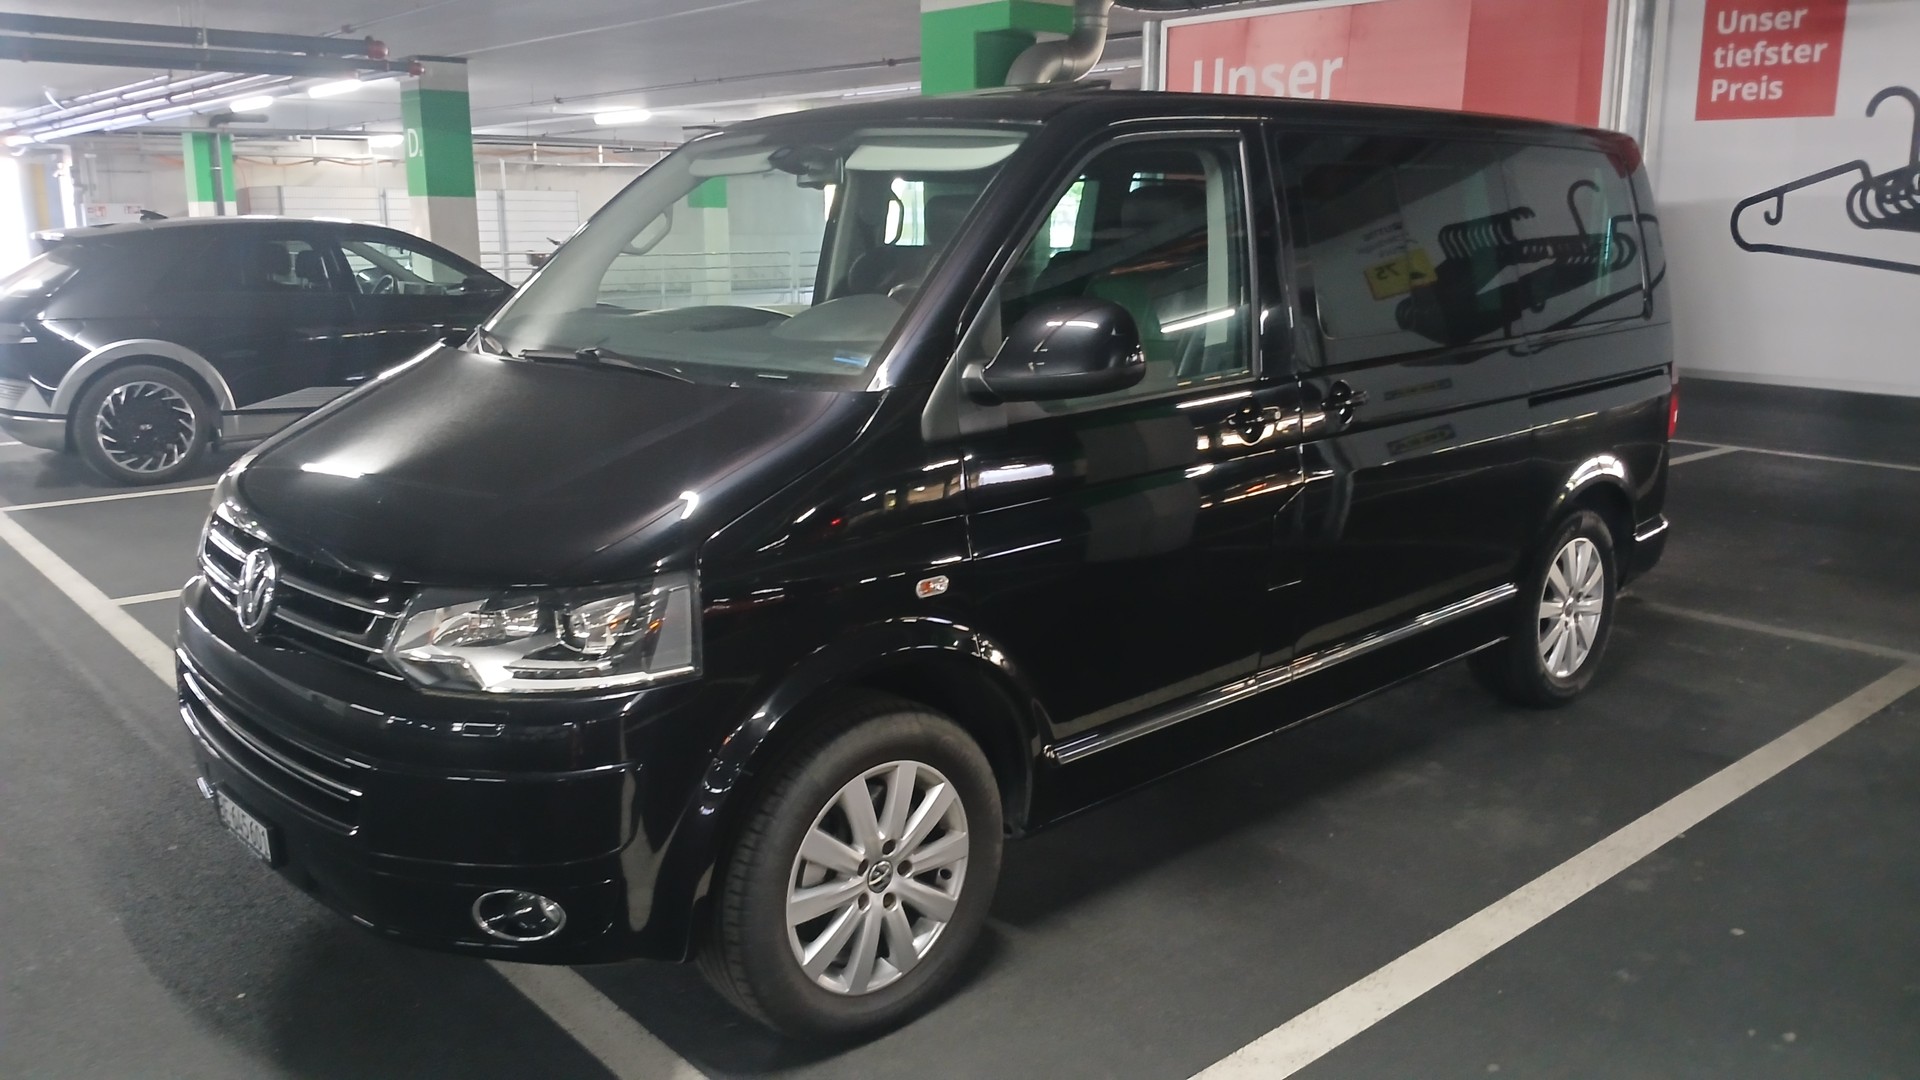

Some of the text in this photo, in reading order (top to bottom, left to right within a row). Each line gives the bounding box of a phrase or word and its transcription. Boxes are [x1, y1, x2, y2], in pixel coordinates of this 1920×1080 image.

[1717, 8, 1808, 35] Unser
[1713, 40, 1829, 69] tiefster
[1192, 57, 1344, 100] Unser
[1711, 75, 1783, 102] Preis
